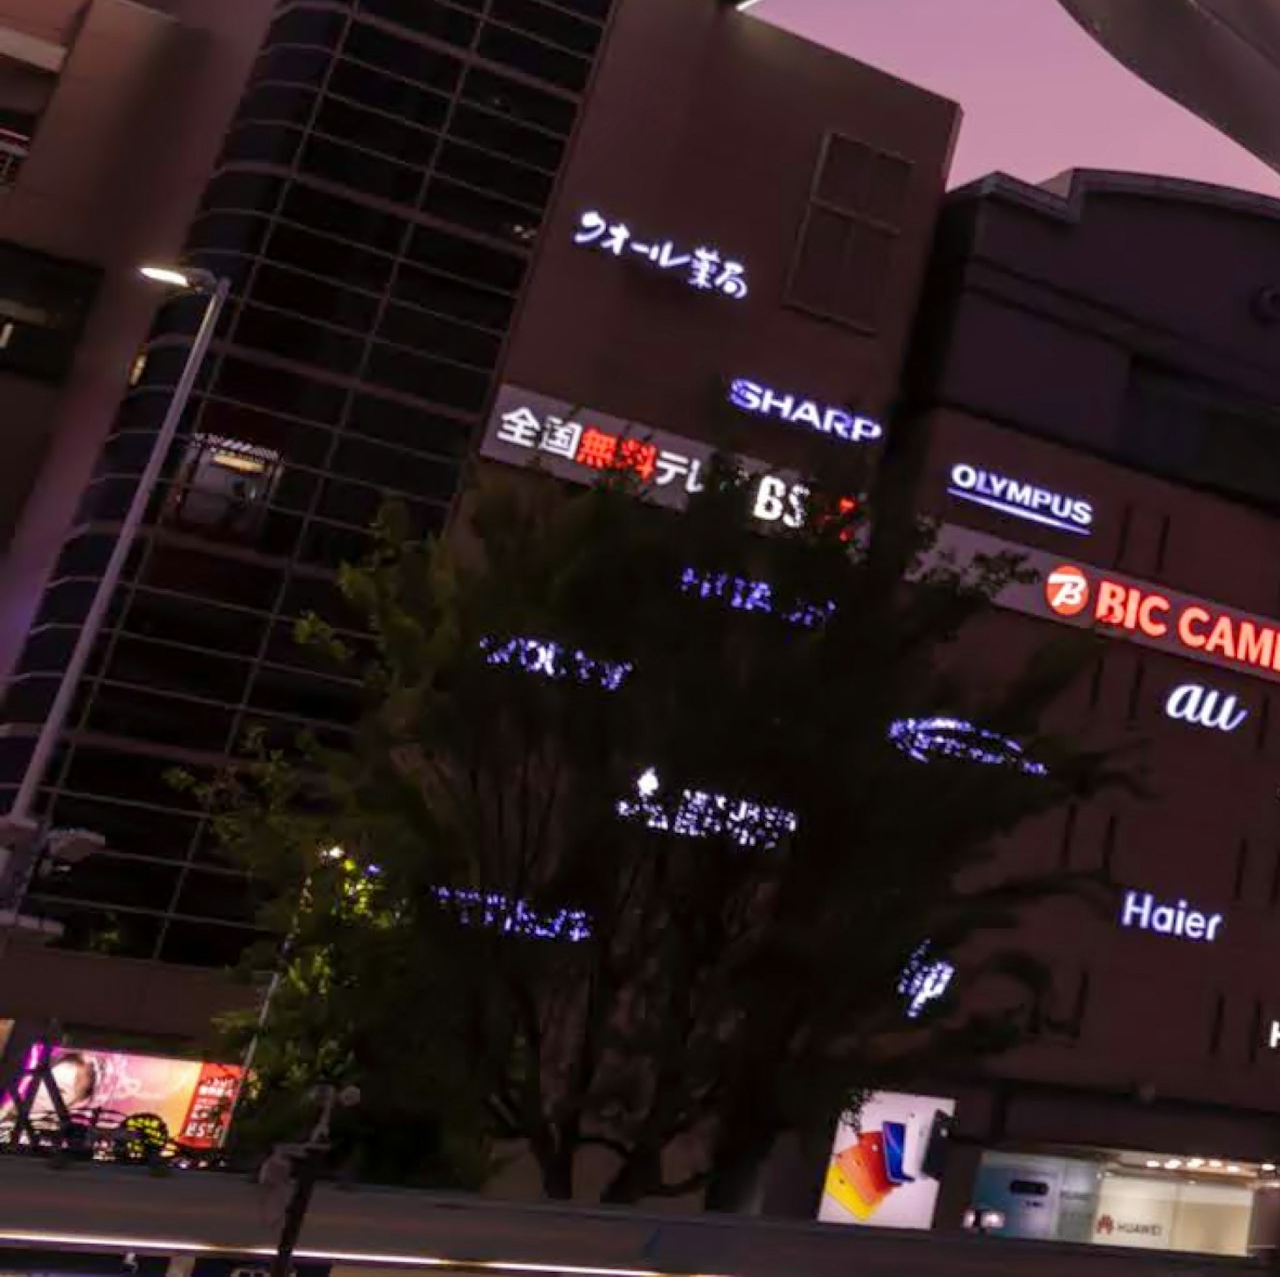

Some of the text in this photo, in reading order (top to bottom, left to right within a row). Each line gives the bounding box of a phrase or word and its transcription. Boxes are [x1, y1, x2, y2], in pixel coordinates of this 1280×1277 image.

[574, 210, 748, 299] クオール薬局
[729, 378, 883, 442] SHARP
[496, 406, 748, 493] 全国無料テレ
[949, 463, 1094, 526] OLYMPUS
[1094, 580, 1171, 638] BIC
[1166, 684, 1248, 732] au
[1121, 890, 1223, 941] Haier
